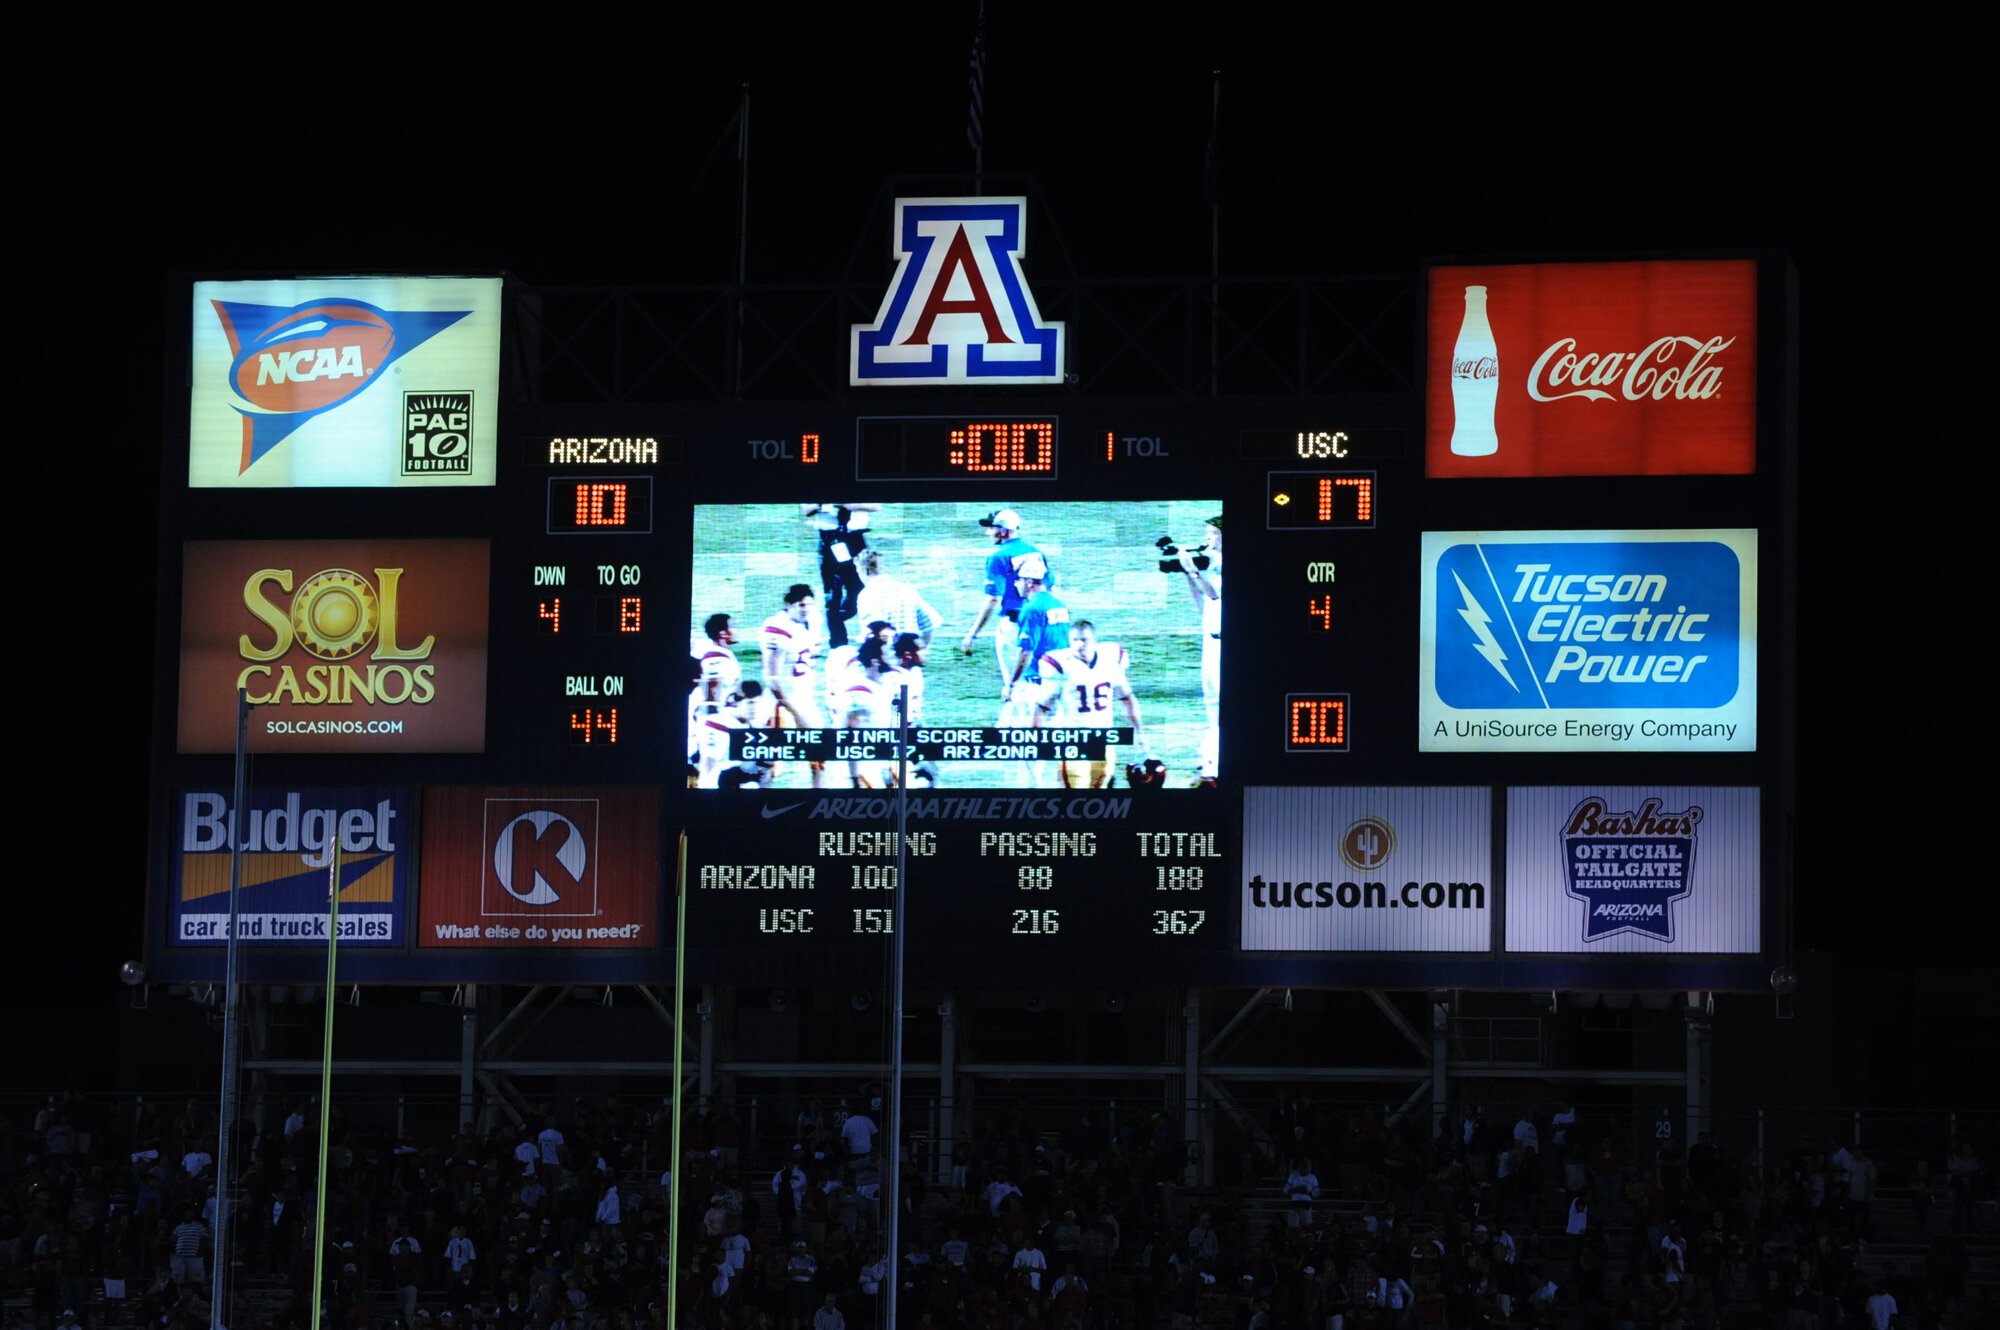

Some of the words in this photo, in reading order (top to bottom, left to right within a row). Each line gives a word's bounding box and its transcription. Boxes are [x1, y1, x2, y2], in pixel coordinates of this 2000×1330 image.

[851, 197, 1064, 386] A
[257, 345, 364, 386] NCAA
[1527, 335, 1736, 402] Coca-Cola
[408, 413, 467, 430] PAC
[408, 432, 467, 457] 10
[549, 438, 658, 464] ARIZONA
[747, 440, 794, 459] TOL
[801, 434, 819, 463] 0
[1122, 437, 1169, 457] TOL
[1297, 432, 1348, 458] USC
[408, 460, 465, 469] FOOTBALL
[575, 484, 627, 525] 10
[1318, 478, 1371, 521] 17
[534, 566, 566, 587] DWN
[597, 565, 615, 585] TO
[620, 565, 641, 586] GO
[1307, 562, 1335, 584] QTR
[1512, 563, 1667, 603] Tucson
[239, 568, 435, 661] SOL
[539, 598, 560, 633] 4
[620, 597, 641, 632] 8
[1310, 595, 1331, 630] 4
[1527, 606, 1710, 643] Electric
[1545, 646, 1708, 683] Power
[236, 664, 436, 705] CASINOS
[566, 676, 598, 696] BALL
[603, 676, 624, 695] ON
[266, 720, 403, 735] SOLCASINOS.COM
[571, 708, 617, 743] 44
[1291, 700, 1344, 744] 00
[1434, 721, 1448, 736] A
[1456, 720, 1557, 737] UniSource
[1565, 720, 1634, 740] Energy
[1641, 720, 1737, 740] Company
[784, 730, 821, 744] THE
[836, 730, 900, 744] FINAL
[917, 730, 984, 744] SCORE
[999, 730, 1120, 743] TONIGHT'S
[742, 746, 806, 759] GAME:
[836, 746, 876, 759] USC
[943, 745, 1038, 758] ARIZONA
[1053, 745, 1087, 758] 10.
[808, 798, 1131, 820] ARIZONAATHLETICS.COM
[1563, 801, 1699, 835] Bashas'
[183, 792, 396, 868] Budget
[819, 832, 937, 856] RUSHING
[980, 831, 1097, 857] PASSING
[1136, 831, 1222, 857] TOTAL
[1575, 844, 1683, 860] OFFICIAL
[700, 865, 815, 889] ARIZONA
[851, 865, 898, 889] 100
[1018, 866, 1053, 890] 88
[1155, 866, 1203, 890] 188
[1574, 862, 1682, 877] TAILGATE
[1248, 874, 1486, 909] tucson.com
[1575, 879, 1682, 890] HEADQUARTERS
[759, 908, 815, 933] USC
[853, 909, 894, 933] 151
[1012, 909, 1060, 934] 216
[1152, 909, 1206, 935] 367
[1593, 904, 1664, 917] ARIZONA
[184, 921, 217, 936] car
[271, 917, 325, 936] truck
[336, 917, 388, 936] sales
[435, 924, 480, 939] What
[485, 924, 520, 939] else
[525, 925, 548, 939] do
[551, 927, 582, 942] you
[586, 924, 640, 939] need?
[1655, 1121, 1671, 1138] 29
